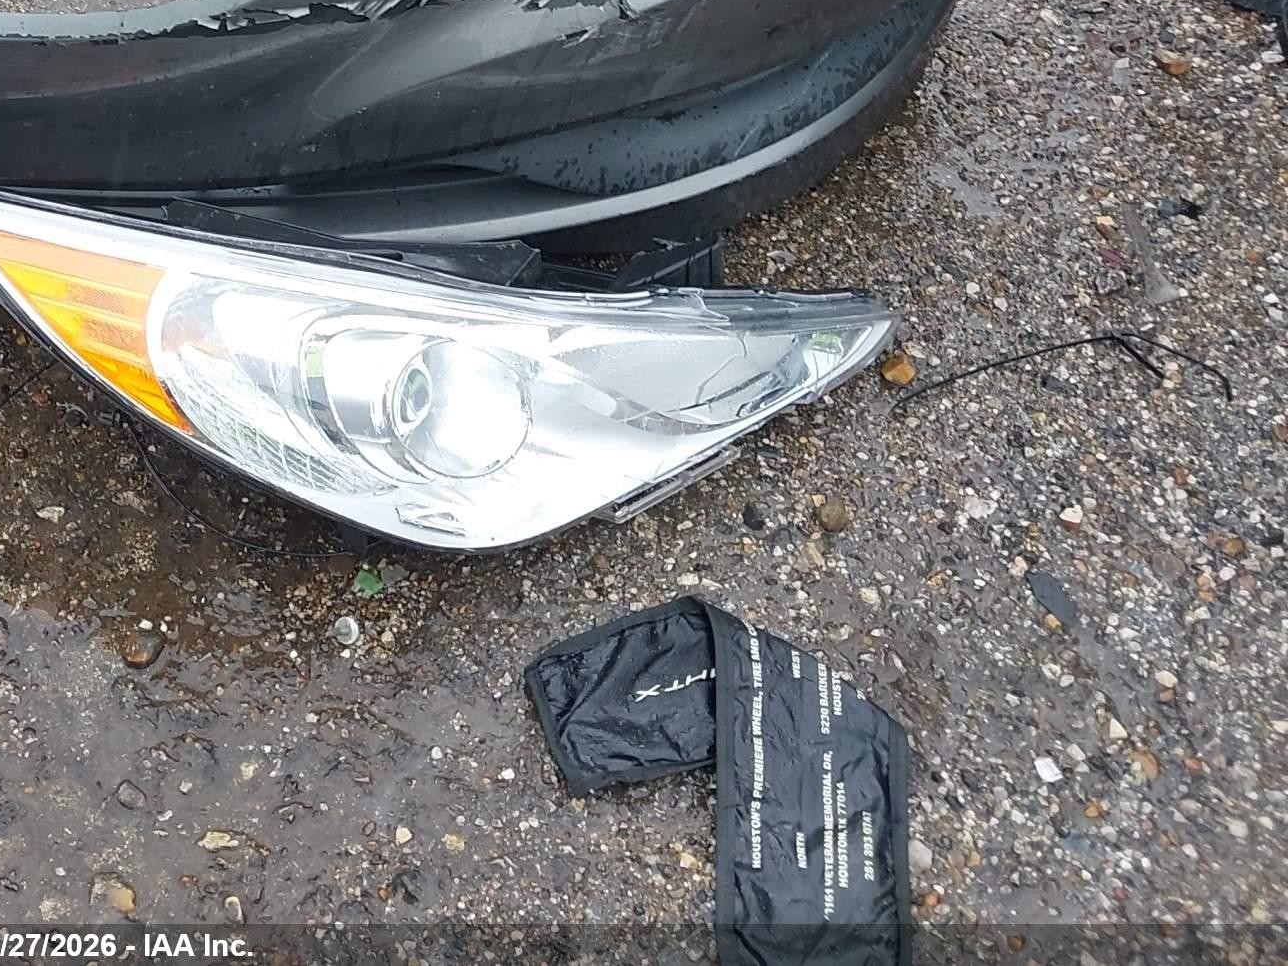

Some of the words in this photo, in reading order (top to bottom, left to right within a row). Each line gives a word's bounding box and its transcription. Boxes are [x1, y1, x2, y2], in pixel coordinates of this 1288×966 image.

[750, 638, 760, 660] AND
[791, 650, 801, 679] WEST
[753, 662, 762, 688] TIRE
[831, 669, 842, 715] HOUSTO
[751, 691, 763, 736] WHEEL,
[820, 708, 830, 735] 5230
[753, 737, 764, 799] PREMIERE
[822, 750, 833, 771] DR,
[822, 772, 833, 829] MEMORIAL
[836, 781, 847, 816] 77014
[751, 801, 762, 869] HOUSTON'S
[796, 832, 807, 869] NORTH
[824, 831, 834, 887] VETERANS
[864, 860, 874, 882] 281
